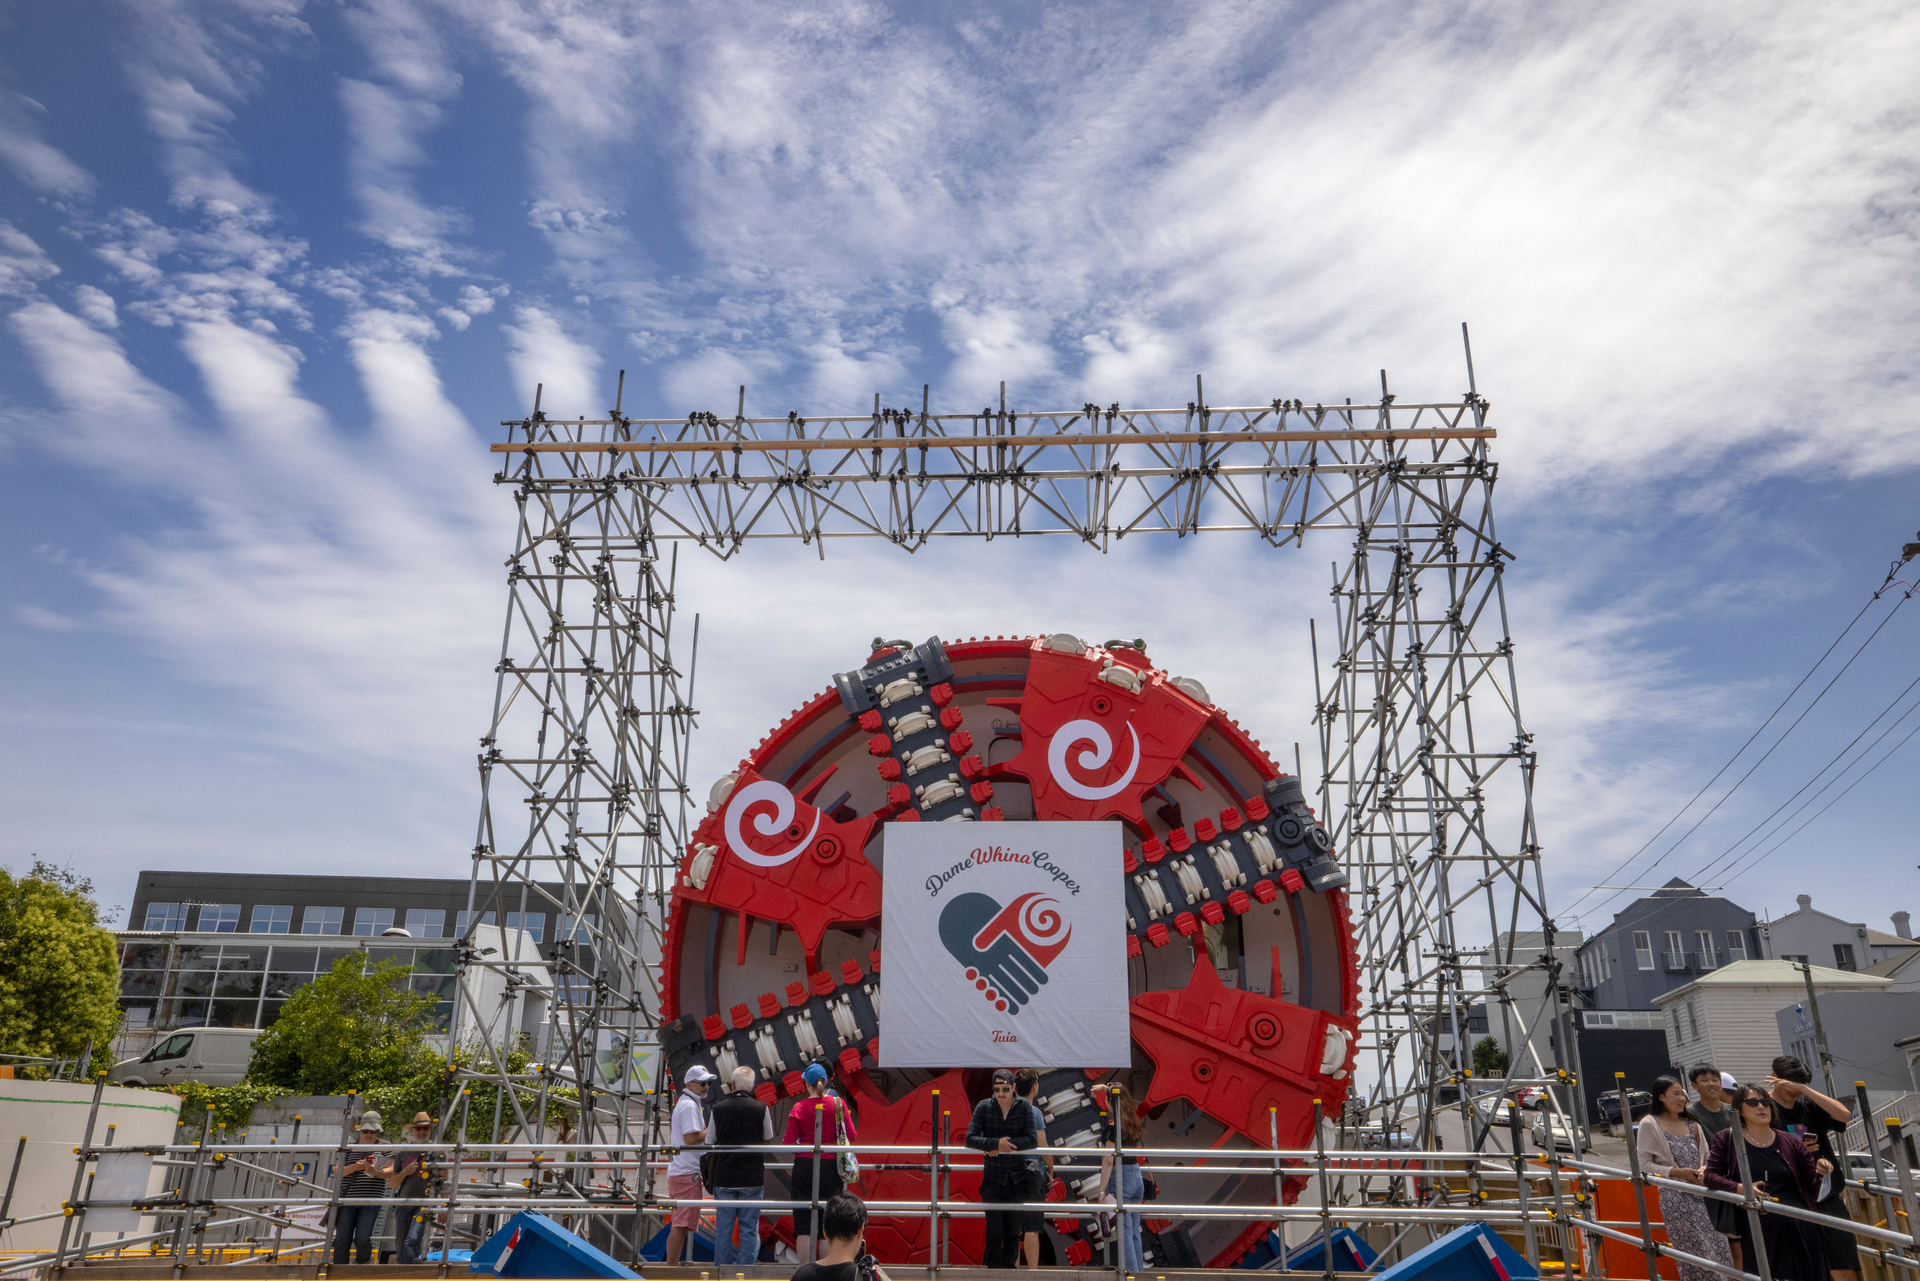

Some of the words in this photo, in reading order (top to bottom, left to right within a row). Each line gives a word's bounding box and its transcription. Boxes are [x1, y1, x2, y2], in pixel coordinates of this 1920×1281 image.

[925, 858, 975, 897] Dame
[970, 845, 1032, 865] Whina
[1032, 850, 1081, 897] Cooper
[991, 1030, 1019, 1043] Tuia
